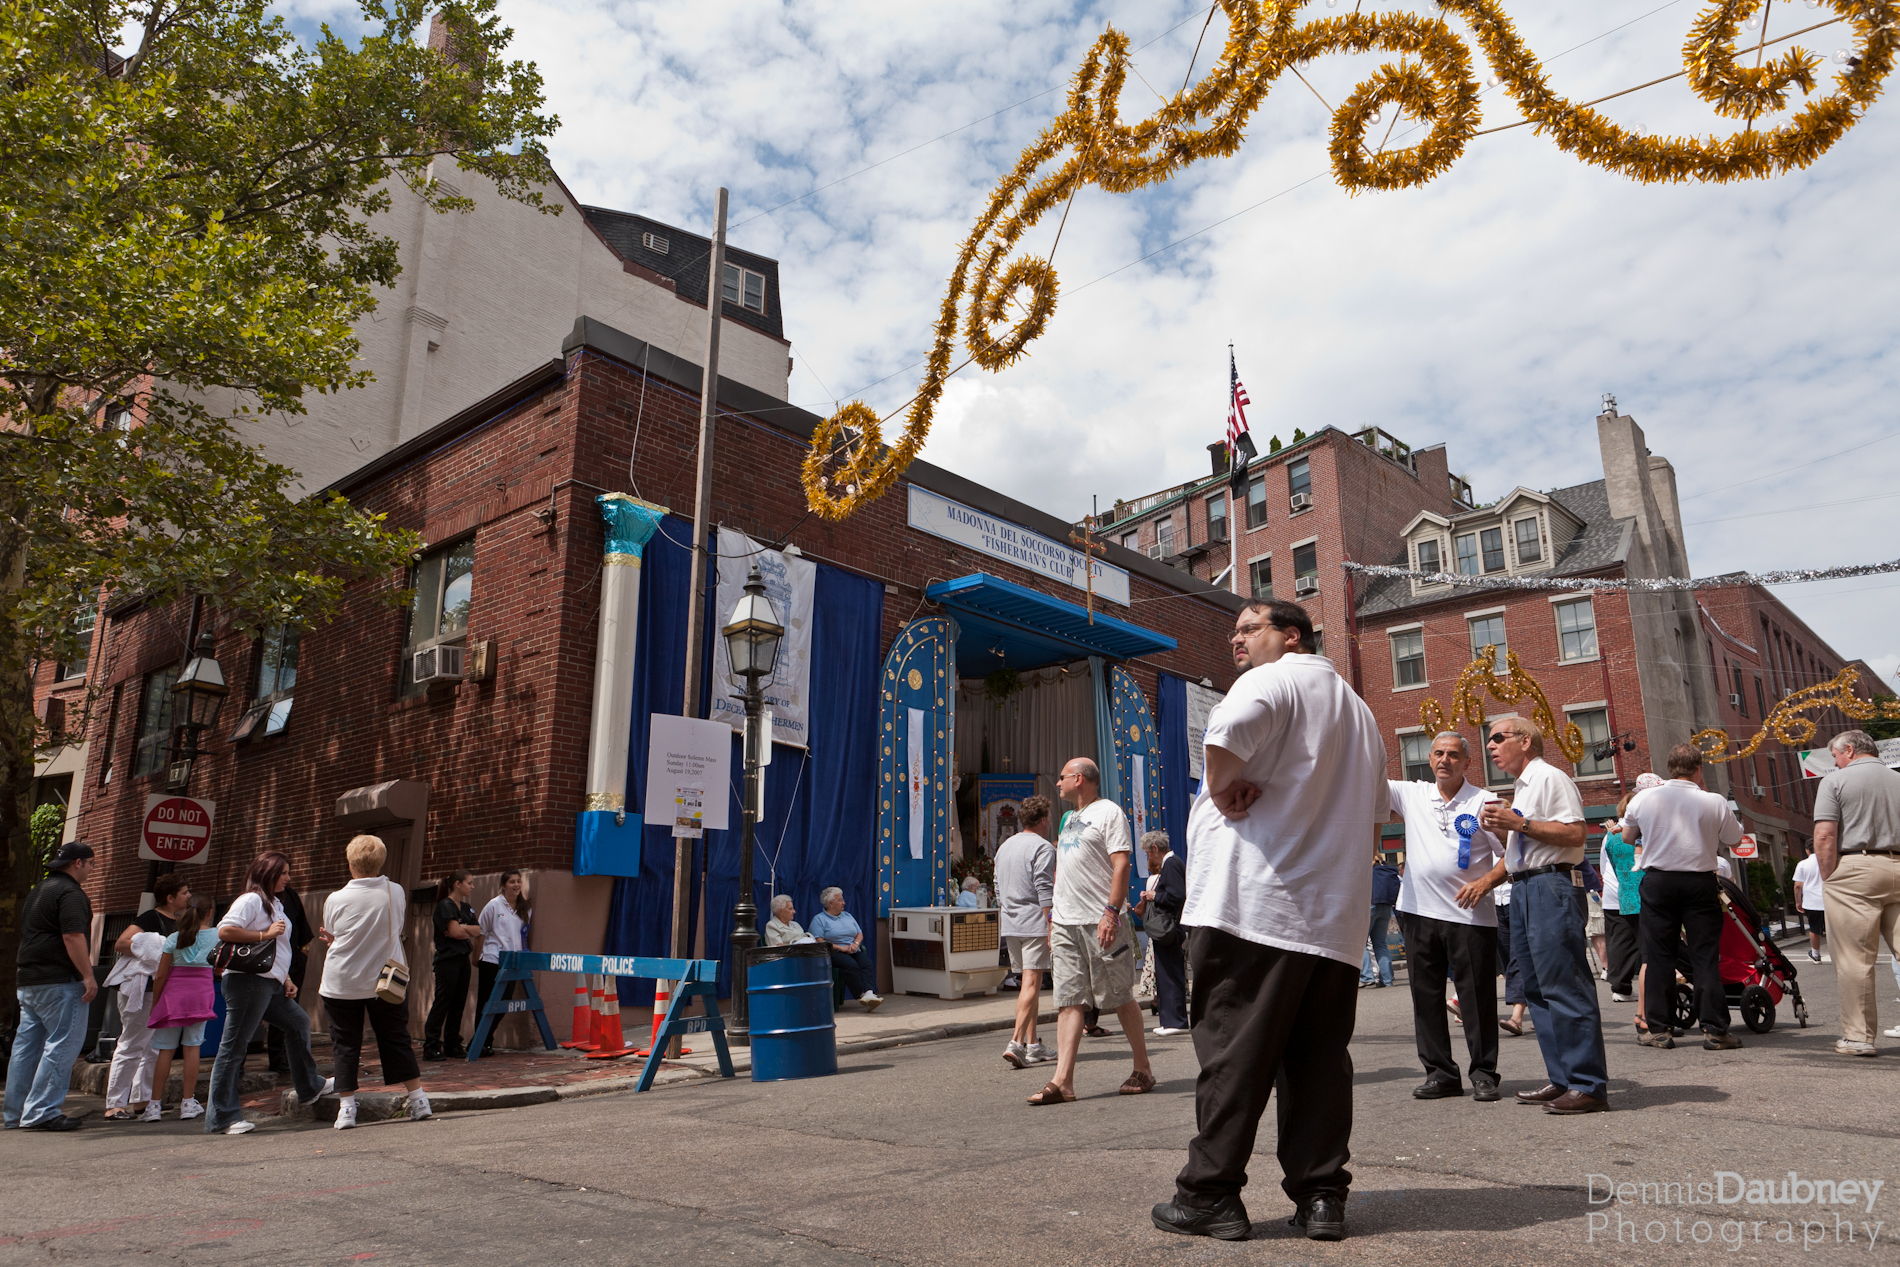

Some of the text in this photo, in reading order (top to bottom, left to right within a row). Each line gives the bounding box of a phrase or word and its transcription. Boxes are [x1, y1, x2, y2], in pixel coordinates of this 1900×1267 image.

[947, 505, 997, 536] MADONNA
[1000, 526, 1018, 544] DEL
[1020, 534, 1066, 562] SOCCORSO
[666, 752, 687, 760] Outdoor
[666, 760, 705, 769] Sunday 11:00am
[666, 767, 684, 775] August
[158, 807, 202, 823] DO NOT
[156, 836, 196, 852] ENTER
[550, 954, 635, 975] BOSTON POLICE
[508, 1000, 527, 1013] BPD
[686, 1020, 707, 1034] BPD
